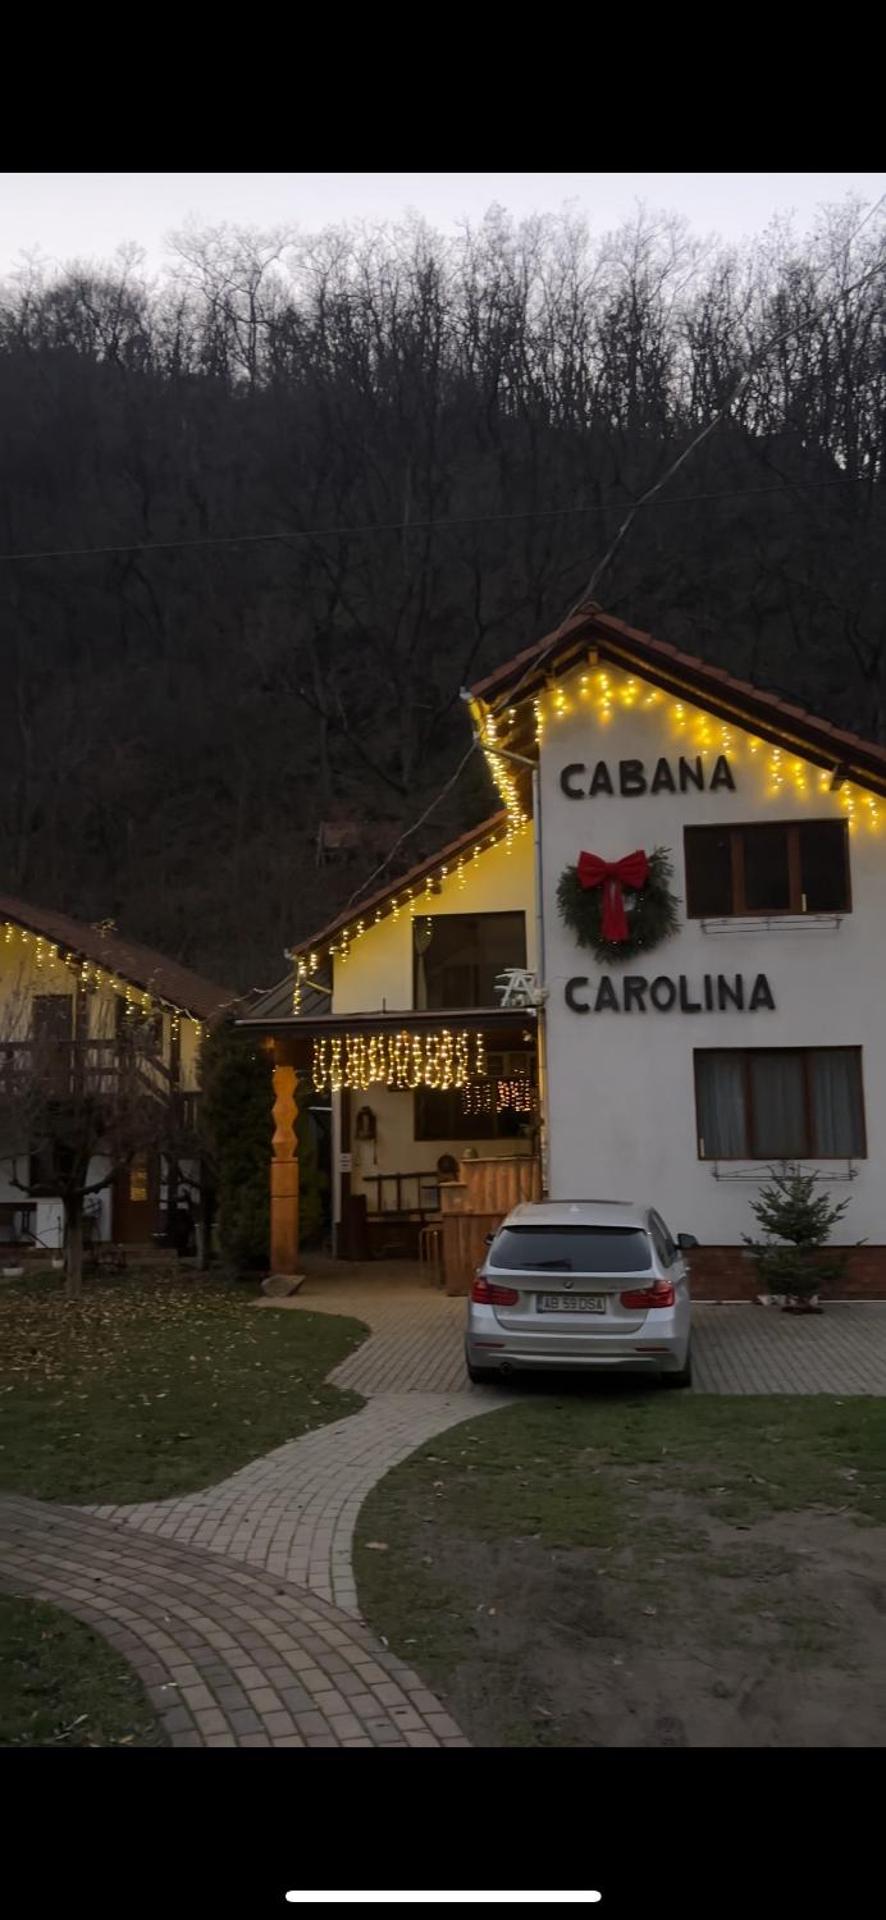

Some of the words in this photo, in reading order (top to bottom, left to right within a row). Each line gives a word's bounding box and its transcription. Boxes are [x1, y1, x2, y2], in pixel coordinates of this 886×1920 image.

[560, 755, 736, 798] CABANA
[564, 974, 776, 1014] CAROLINA
[543, 1297, 559, 1309] AB
